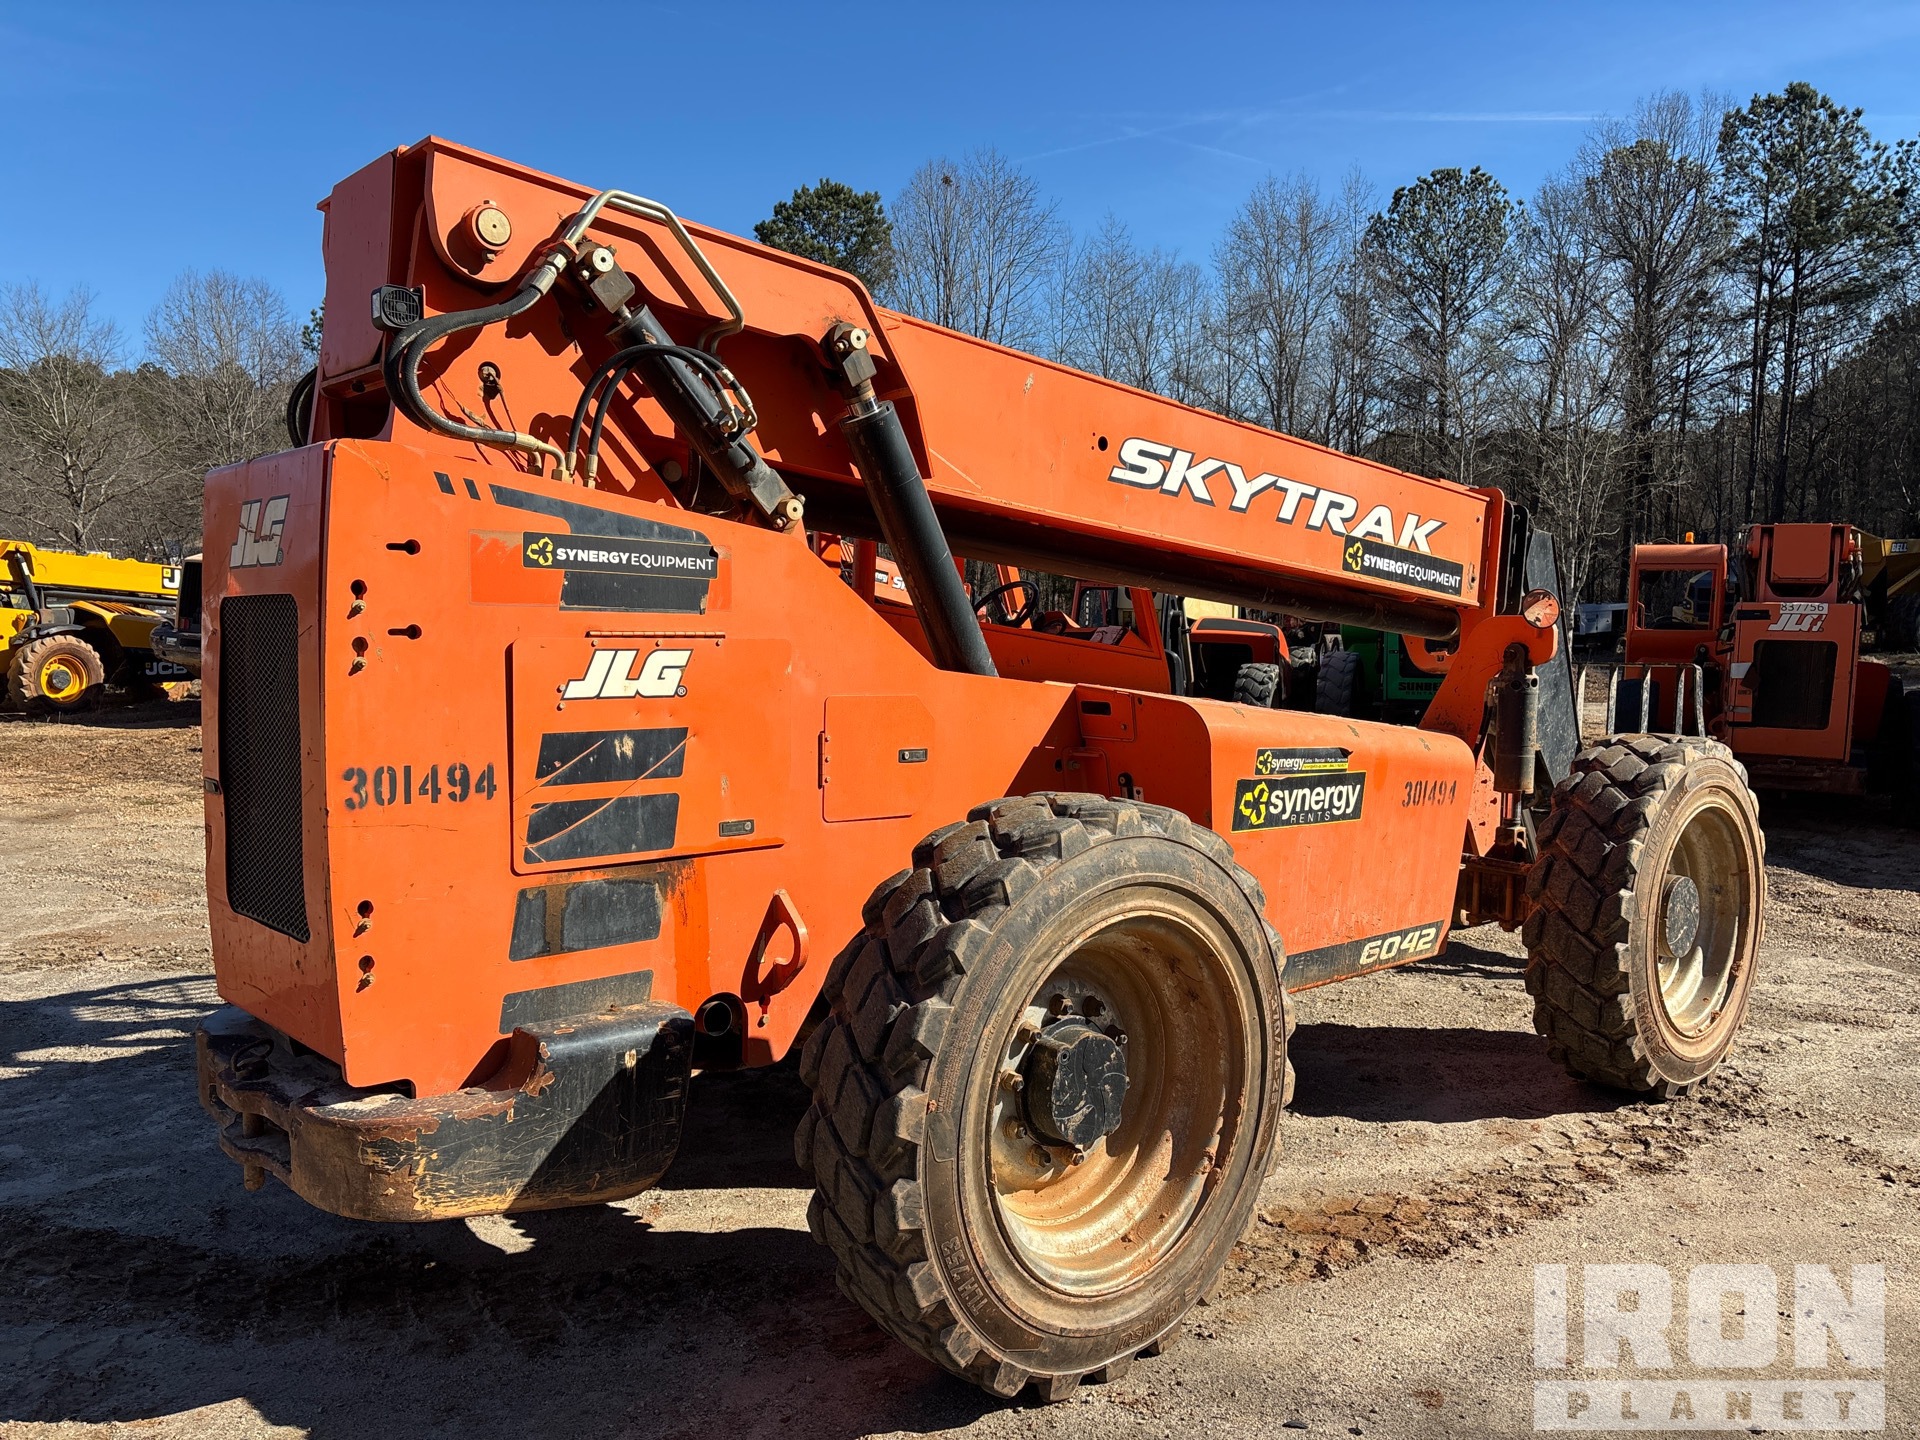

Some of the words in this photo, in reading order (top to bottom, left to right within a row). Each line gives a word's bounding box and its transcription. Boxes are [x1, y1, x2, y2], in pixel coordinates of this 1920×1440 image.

[1108, 437, 1448, 553] SKYTRAK
[229, 494, 290, 569] JLG
[1891, 542, 1908, 552] BELL
[1767, 613, 1827, 632] JLG
[145, 662, 188, 676] JCB
[560, 648, 694, 701] JLG
[1398, 682, 1441, 691] SUNBE
[1271, 757, 1305, 771] synergy
[342, 762, 498, 811] 301494
[1269, 784, 1361, 820] synergy
[1290, 811, 1331, 824] RENTS
[1359, 927, 1437, 965] 6042
